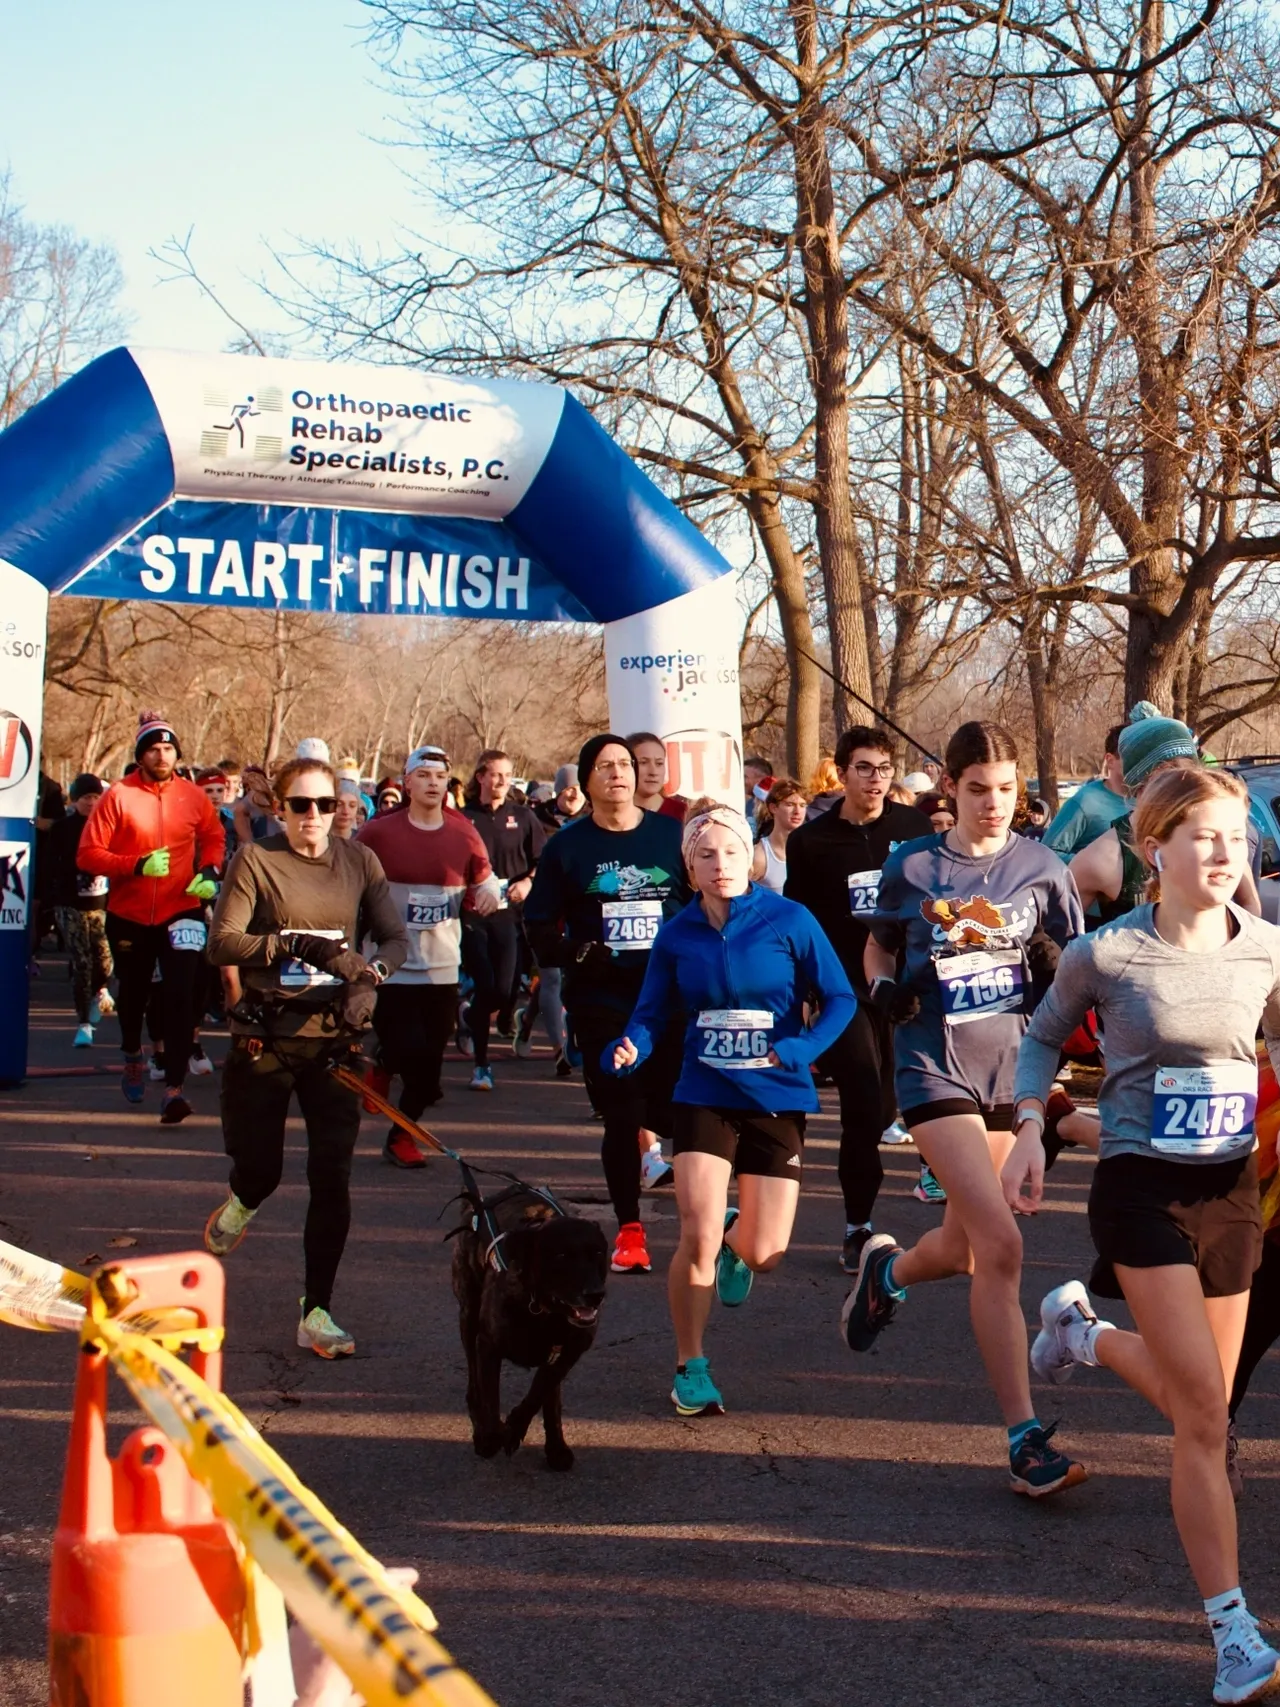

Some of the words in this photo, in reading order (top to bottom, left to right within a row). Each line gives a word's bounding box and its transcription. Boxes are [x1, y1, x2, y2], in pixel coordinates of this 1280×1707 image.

[291, 390, 472, 423] Orthopaedic
[291, 416, 383, 444] Rehab
[289, 445, 453, 480] Specialists,
[462, 458, 510, 481] P.C.
[204, 468, 245, 477] Physical
[248, 471, 287, 481] Therapy
[297, 475, 335, 484] Athletic
[337, 479, 376, 488] Training
[386, 482, 446, 492] Performance
[447, 487, 491, 496] Coaching
[140, 534, 324, 600] START
[359, 548, 530, 610] FINISH
[620, 649, 725, 674] experiene
[596, 860, 620, 873] 2012
[412, 905, 449, 923] 2281
[961, 920, 989, 934] JACKSON
[172, 929, 206, 946] 2005
[607, 917, 659, 940] 2465
[948, 967, 1014, 1010] 2156
[703, 1029, 768, 1057] 2346
[1164, 1095, 1246, 1136] 2473
